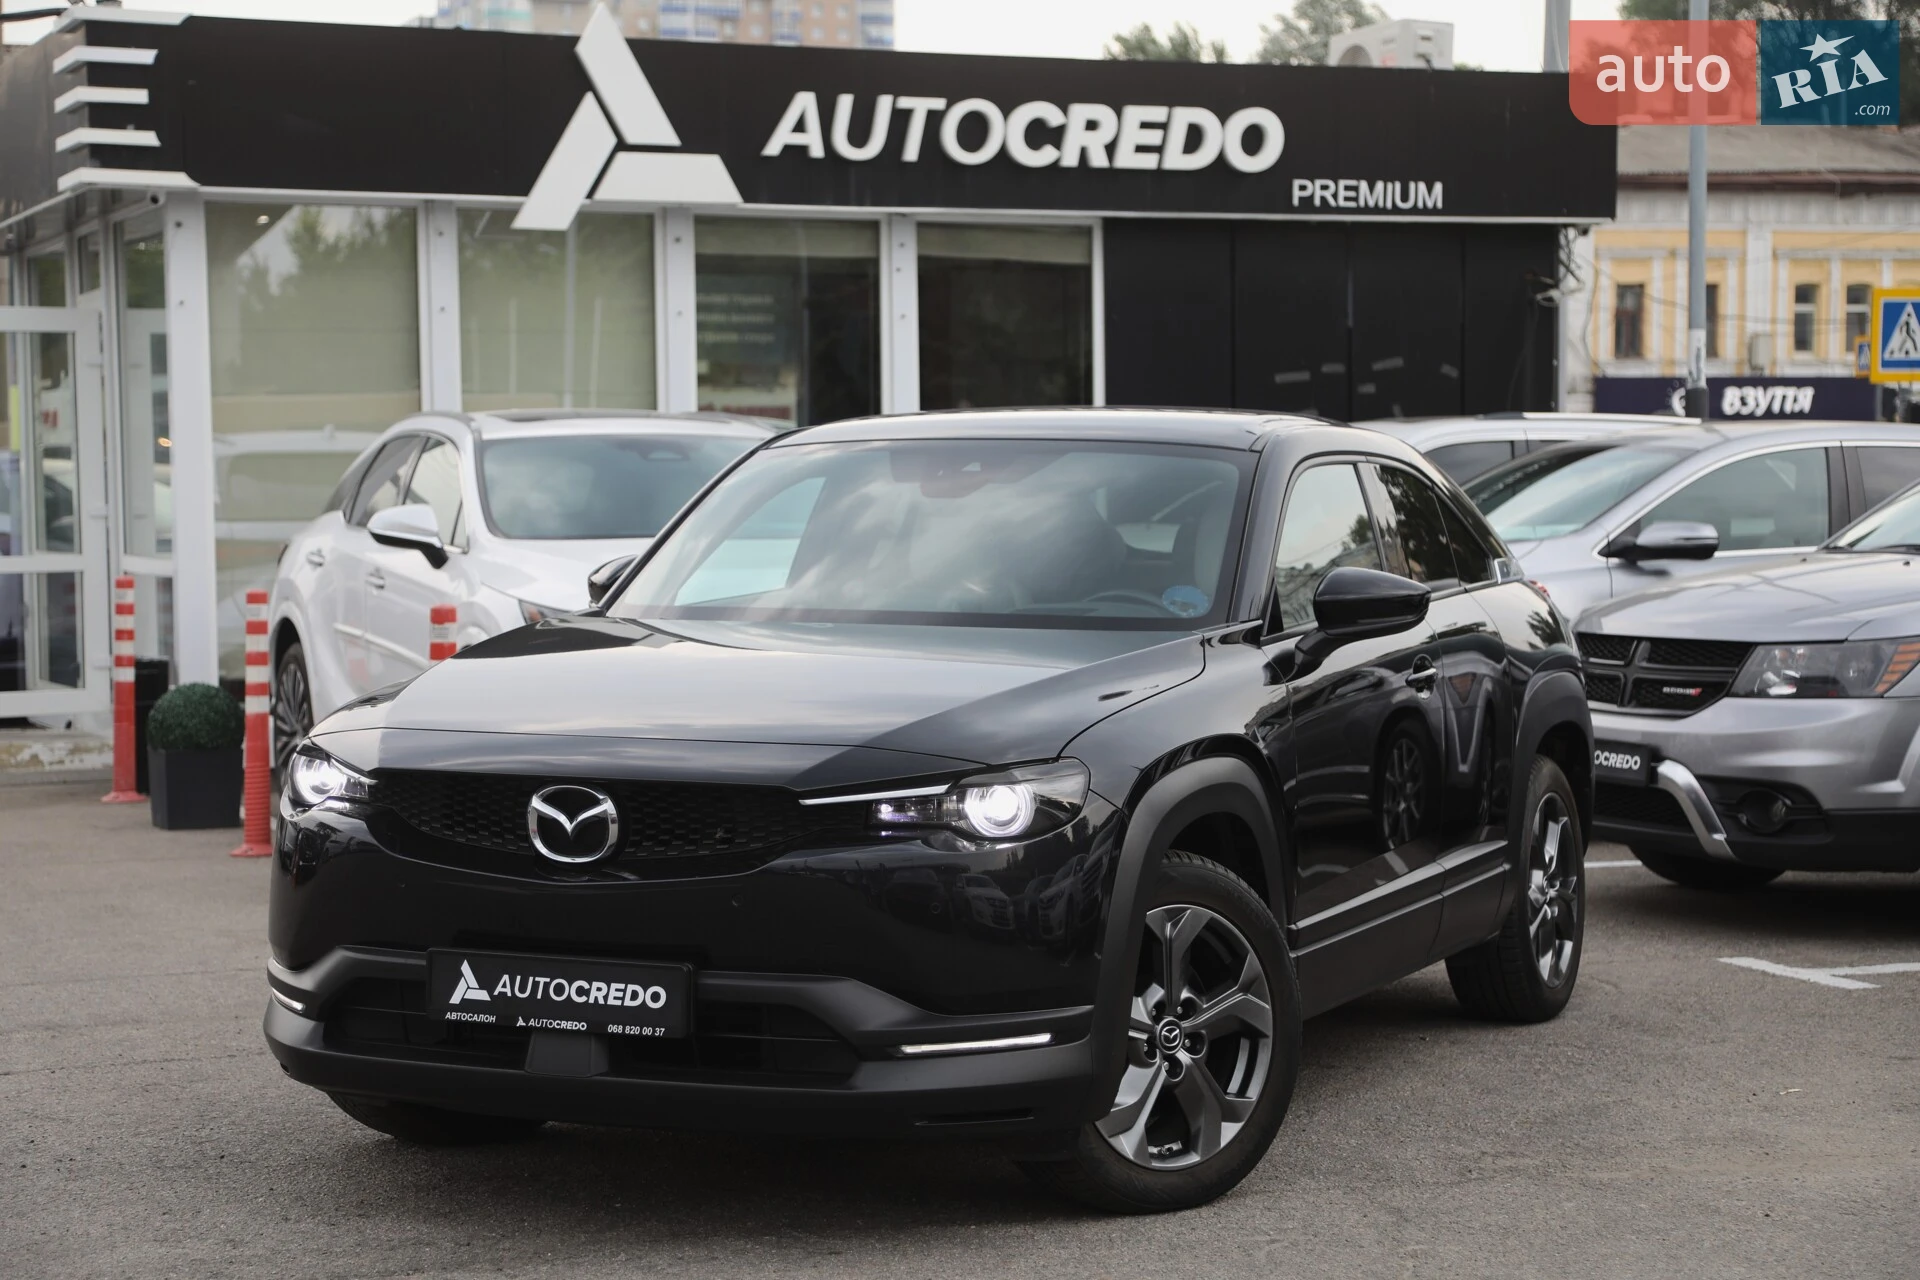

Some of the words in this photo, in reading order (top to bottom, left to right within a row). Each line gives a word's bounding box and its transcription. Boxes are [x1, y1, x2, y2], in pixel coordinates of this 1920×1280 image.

[760, 90, 1286, 174] AUTOCREDO
[1291, 178, 1444, 211] PREMIUM
[1594, 749, 1641, 771] OCREDO
[493, 974, 667, 1009] AUTOCREDO
[445, 1011, 496, 1024] АВТОСАЛОН
[528, 1018, 587, 1031] AUTOCREDO
[607, 1023, 623, 1034] 068
[624, 1025, 640, 1035] 820
[642, 1026, 653, 1036] 00
[654, 1027, 665, 1037] 37
